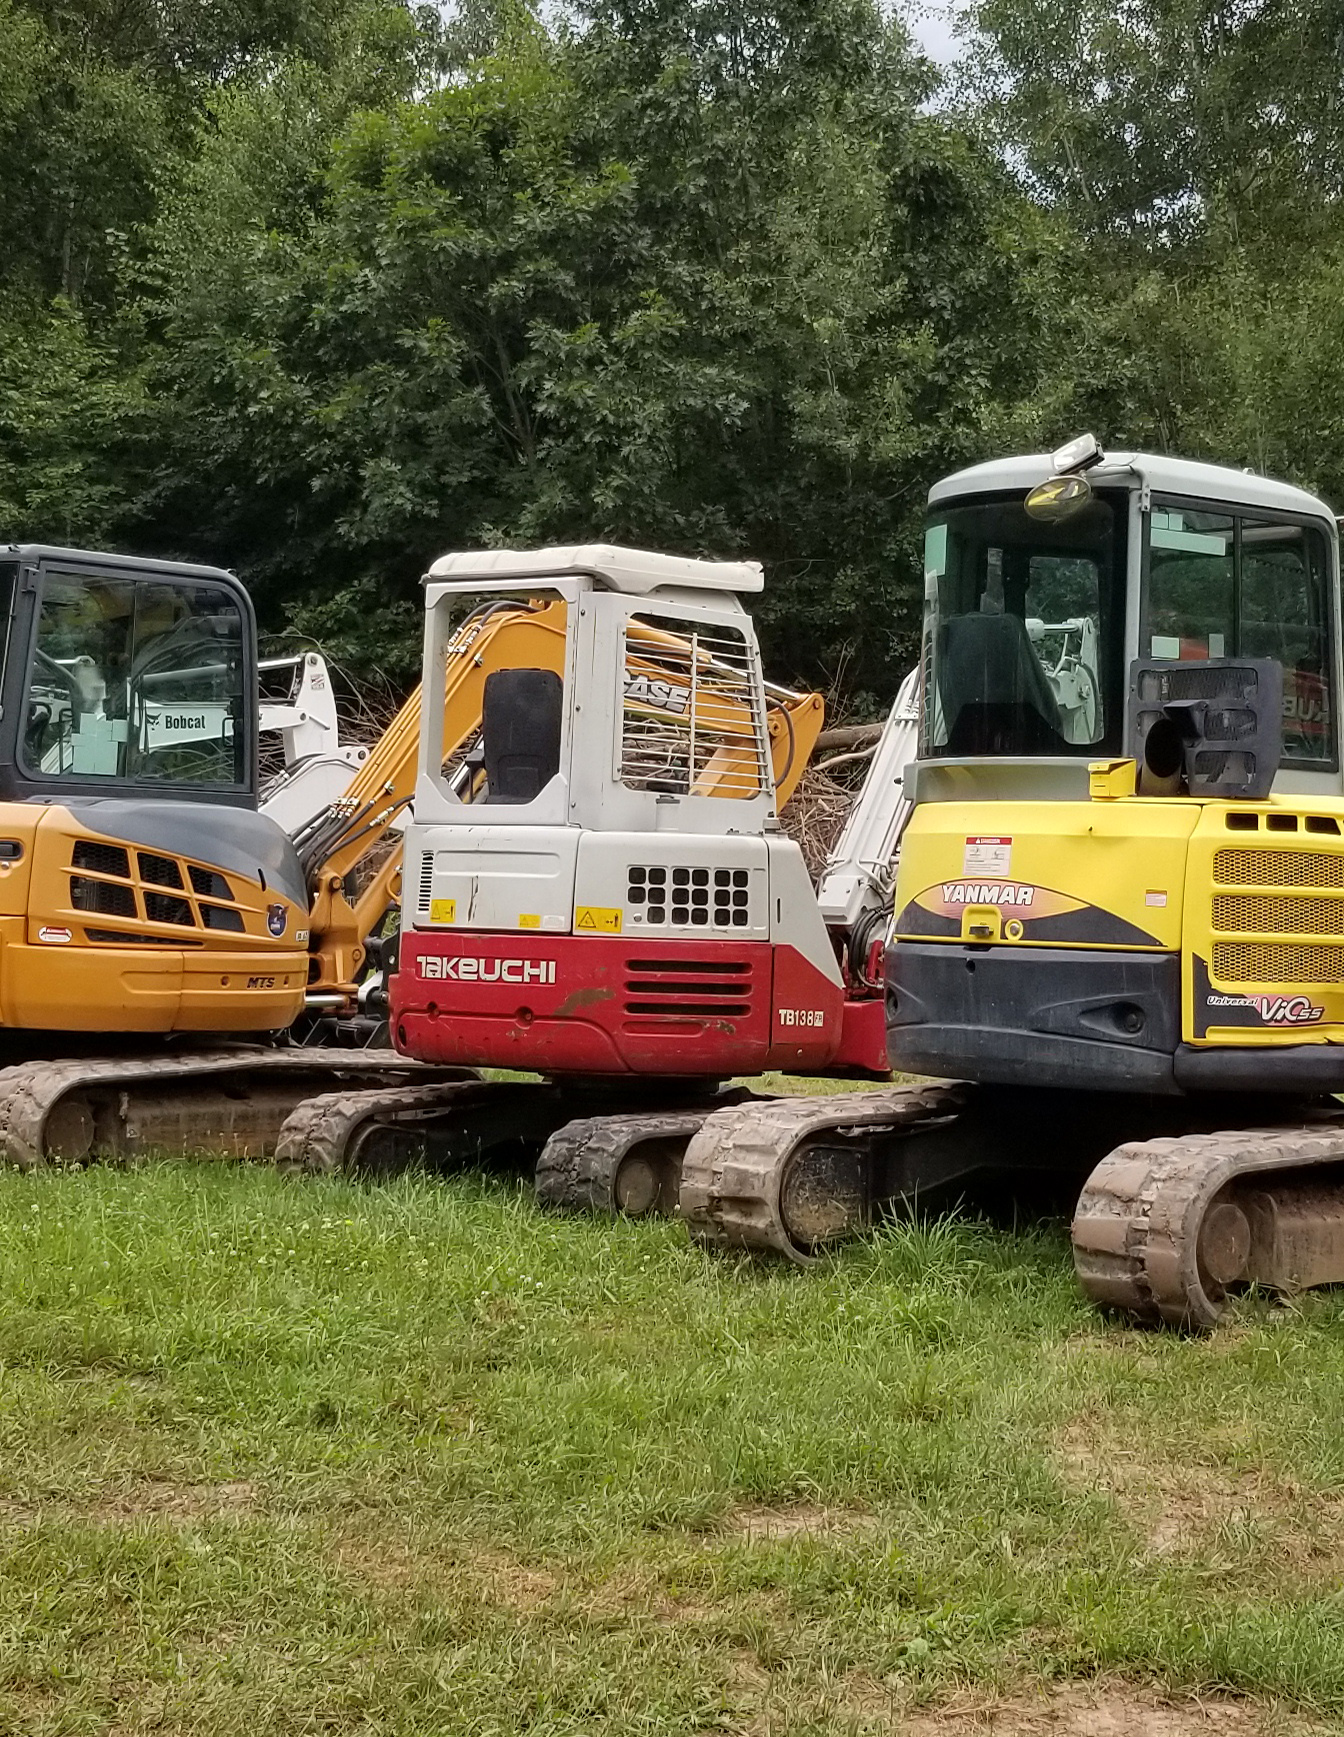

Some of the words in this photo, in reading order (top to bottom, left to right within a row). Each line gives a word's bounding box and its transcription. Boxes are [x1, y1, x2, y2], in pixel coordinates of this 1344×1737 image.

[165, 715, 206, 730] Bobcat
[942, 884, 1034, 906] YANMAR
[247, 977, 275, 989] MTS
[1207, 996, 1258, 1006] Universal
